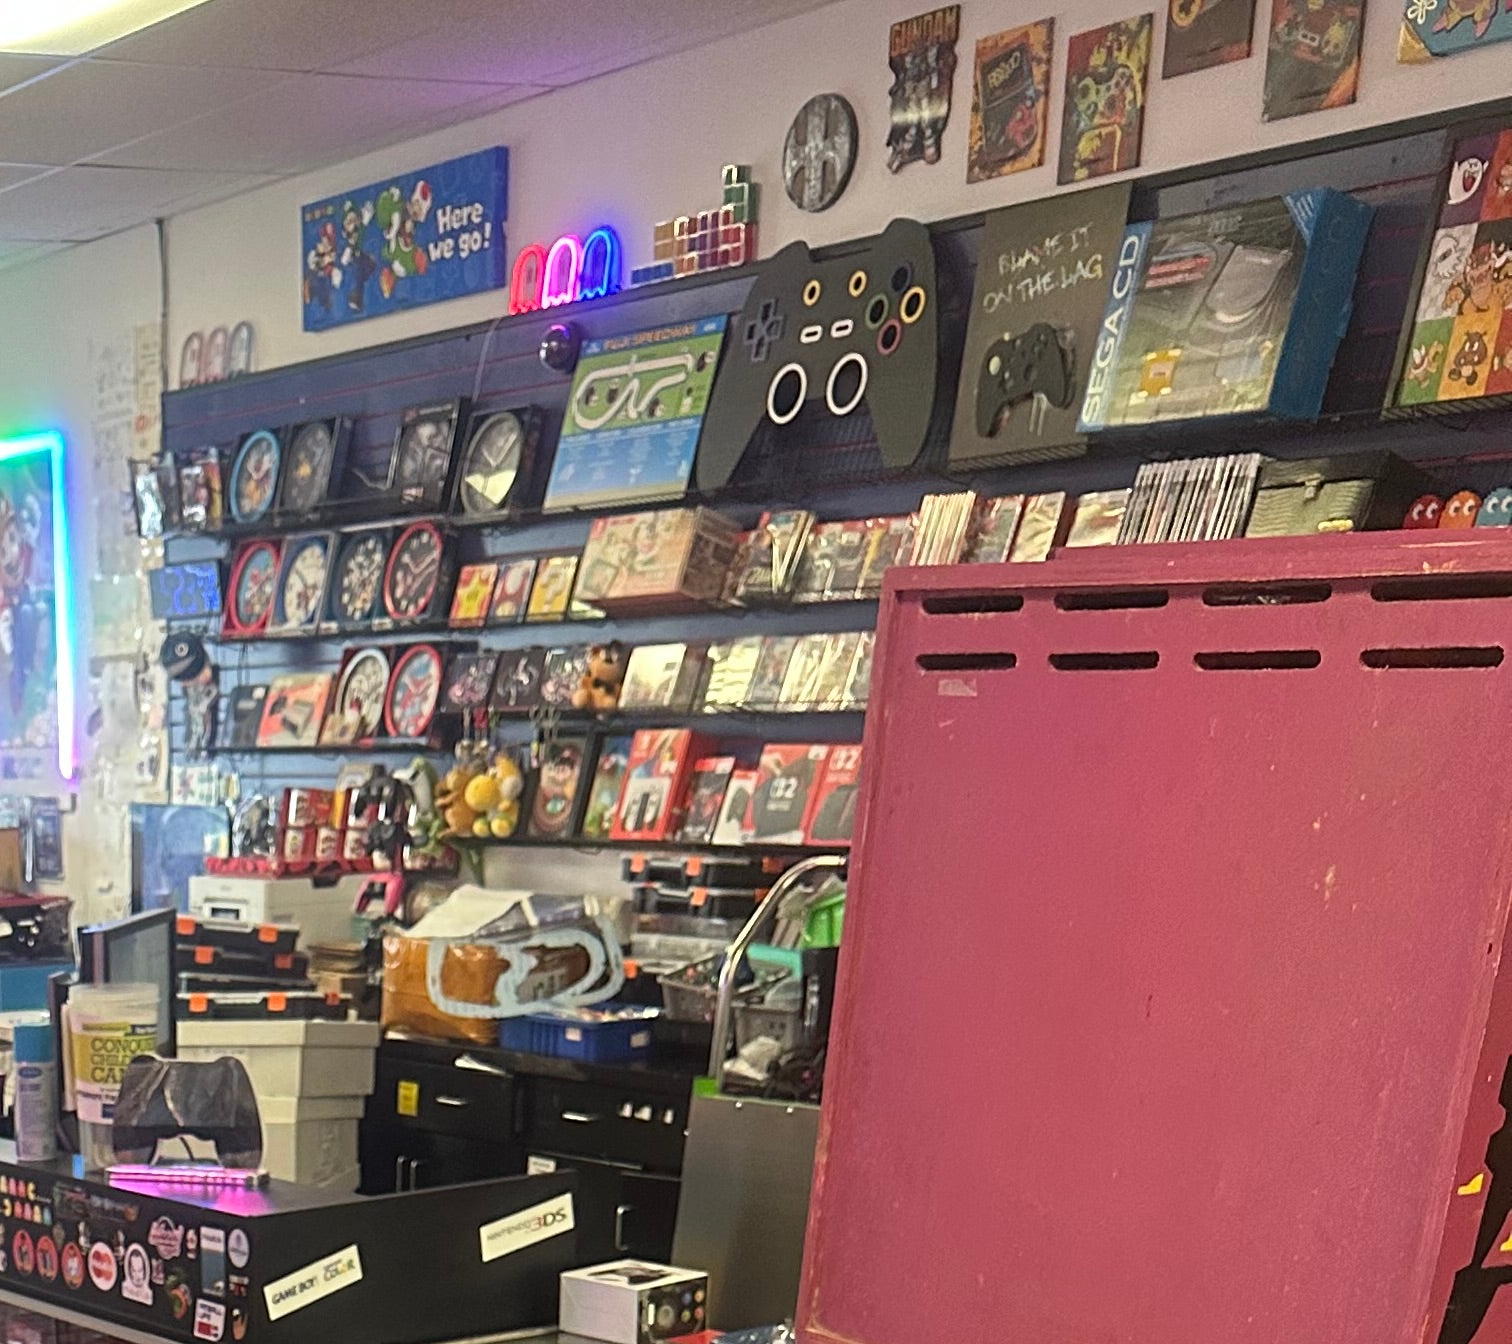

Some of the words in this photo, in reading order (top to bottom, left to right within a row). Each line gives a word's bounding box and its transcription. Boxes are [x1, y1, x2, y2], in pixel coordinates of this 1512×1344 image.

[437, 203, 484, 234] Here
[428, 238, 454, 261] we
[458, 222, 492, 259] go!
[999, 235, 1062, 275] BLAME
[1069, 223, 1092, 250] IT
[983, 289, 1013, 312] ON
[1017, 270, 1053, 297] THE
[1060, 254, 1103, 289] LAG
[1081, 306, 1124, 423] SEGA
[1112, 235, 1140, 299] CD
[531, 1207, 567, 1232] 3DS
[272, 1286, 296, 1304] GAME
[299, 1277, 316, 1293] BOY
